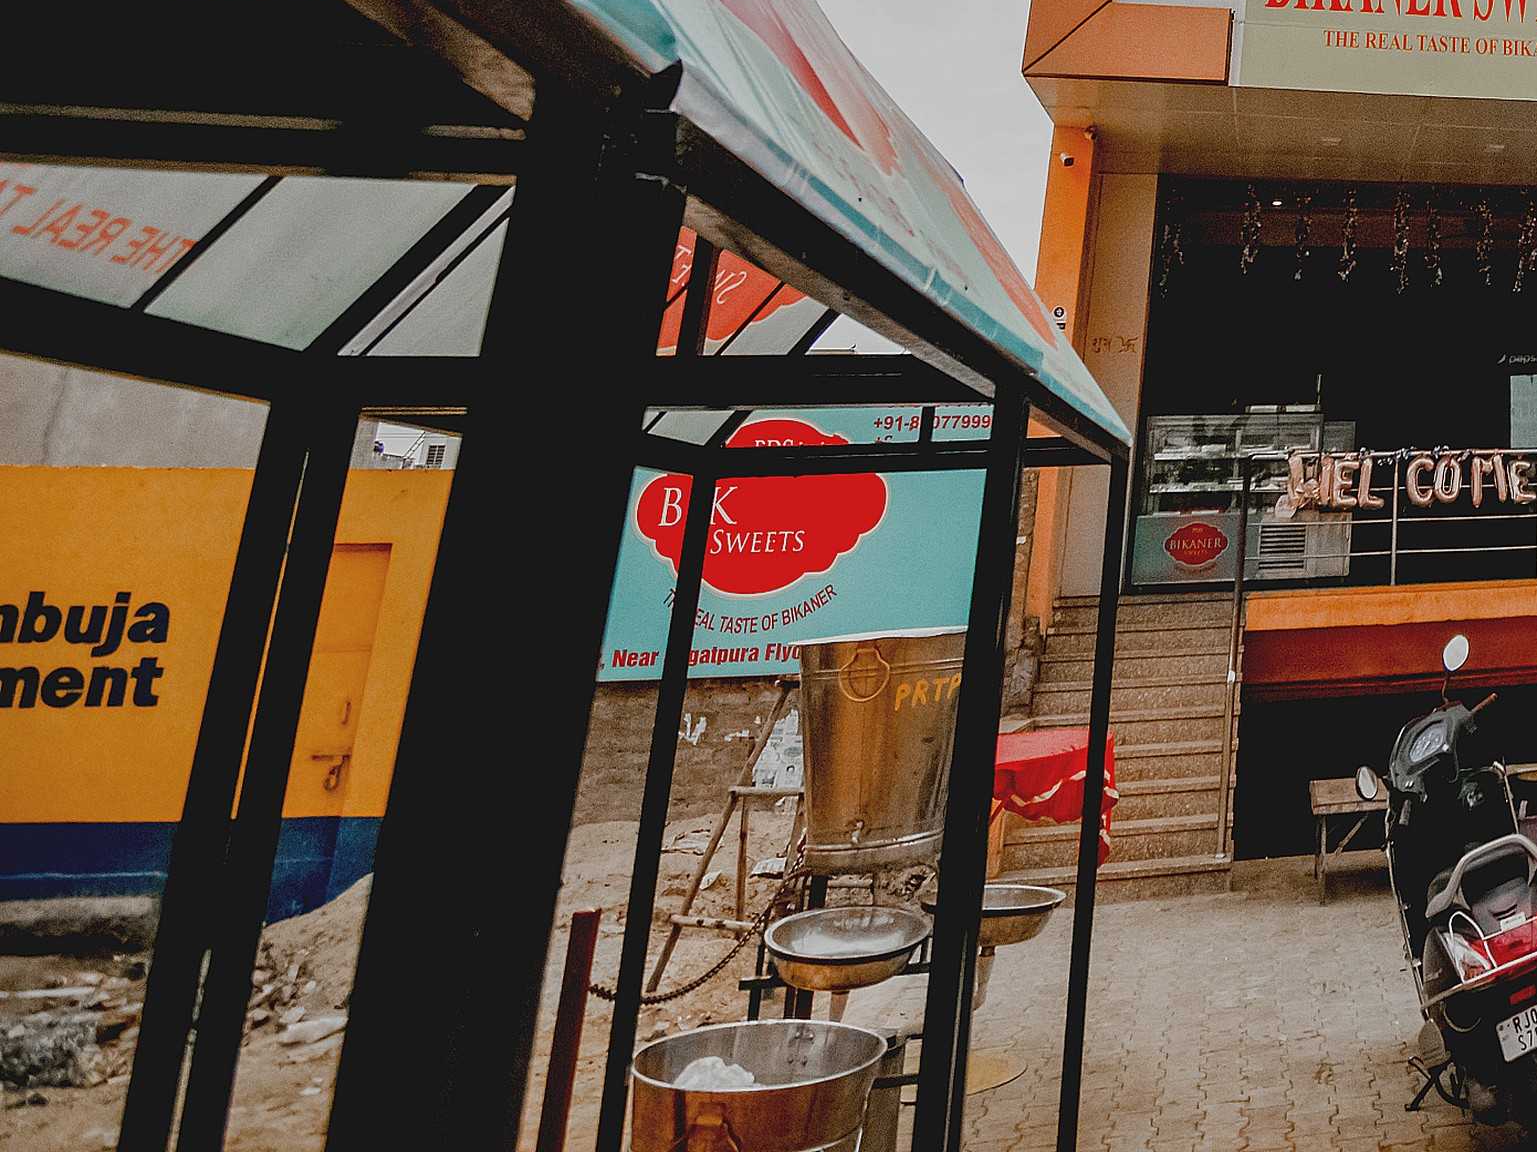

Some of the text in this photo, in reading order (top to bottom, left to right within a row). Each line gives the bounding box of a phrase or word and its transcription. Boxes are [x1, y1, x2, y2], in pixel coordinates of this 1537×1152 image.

[1323, 29, 1359, 49] THE
[1365, 32, 1413, 51] REAL
[1416, 34, 1470, 55] TASTE
[1475, 37, 1499, 55] OF
[657, 485, 738, 527] BK
[709, 529, 806, 555] SWEETS
[1169, 537, 1221, 550] BIKANER
[719, 615, 758, 634] TASTE
[761, 612, 778, 631] OF
[782, 584, 838, 626] BIKANER
[611, 649, 660, 668] Near
